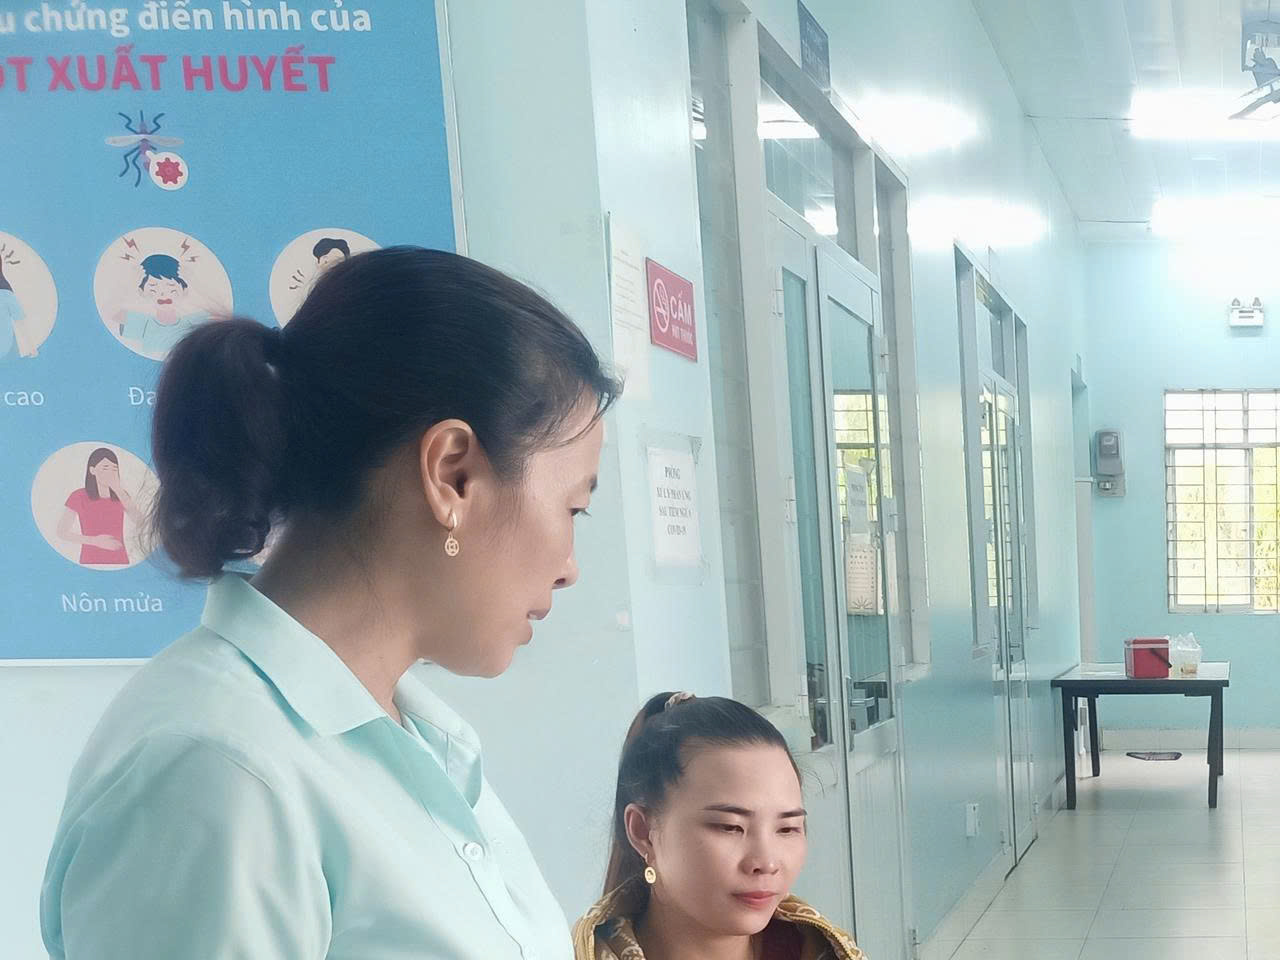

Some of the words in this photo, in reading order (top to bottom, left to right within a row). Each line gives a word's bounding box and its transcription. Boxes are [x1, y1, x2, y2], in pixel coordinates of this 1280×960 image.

[222, 1, 301, 30] hình
[311, 0, 371, 31] của
[0, 55, 33, 91] T
[47, 44, 167, 91] XUẤT
[182, 44, 336, 91] HUYẾT
[4, 391, 44, 406] cao
[128, 386, 157, 406] Đa
[61, 592, 107, 612] Nôn
[114, 592, 163, 612] mửa
